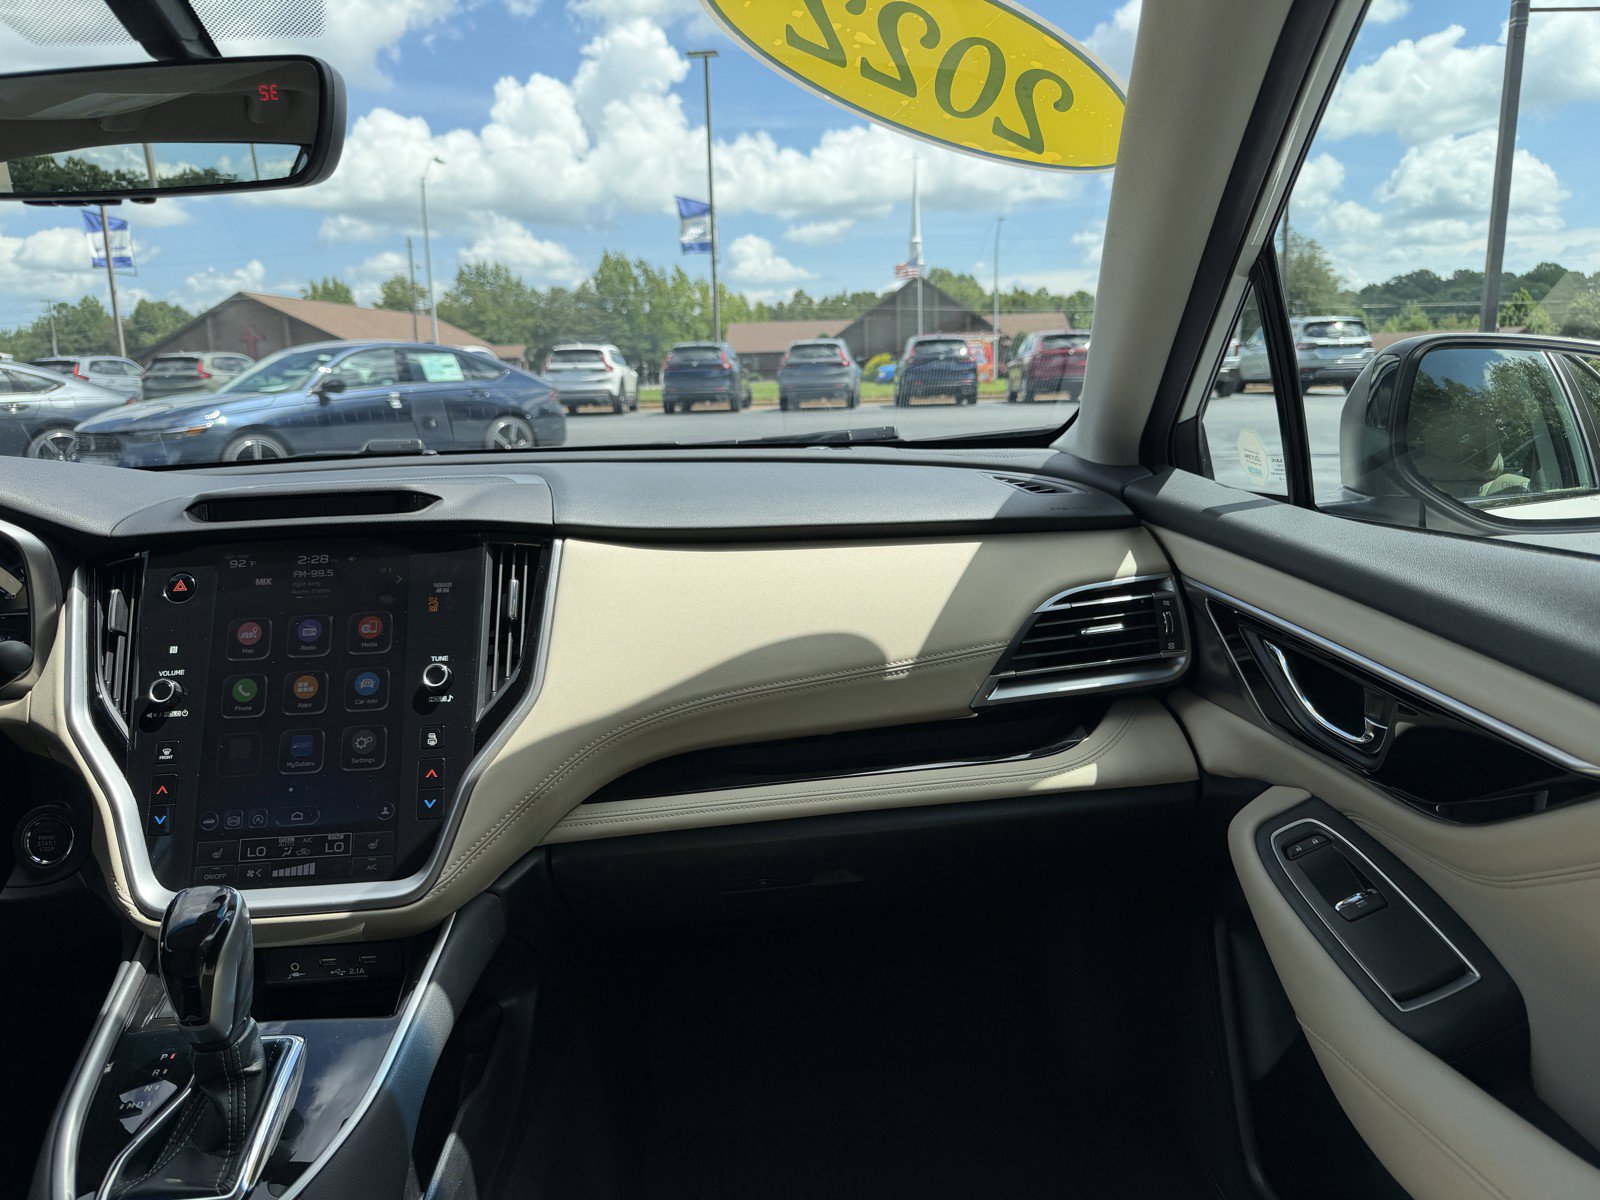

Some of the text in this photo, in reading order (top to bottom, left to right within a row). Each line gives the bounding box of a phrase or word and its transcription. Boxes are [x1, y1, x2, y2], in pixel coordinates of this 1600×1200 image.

[229, 559, 247, 569] 92
[297, 554, 329, 565] 2:28
[293, 569, 335, 579] FM-99.5
[255, 577, 273, 587] MIX
[158, 669, 186, 677] VOLUME
[286, 760, 316, 769] MySubaru
[351, 757, 376, 765] Settings
[246, 846, 267, 857] LO
[325, 841, 345, 853] LO
[203, 873, 227, 881] ON/OFF
